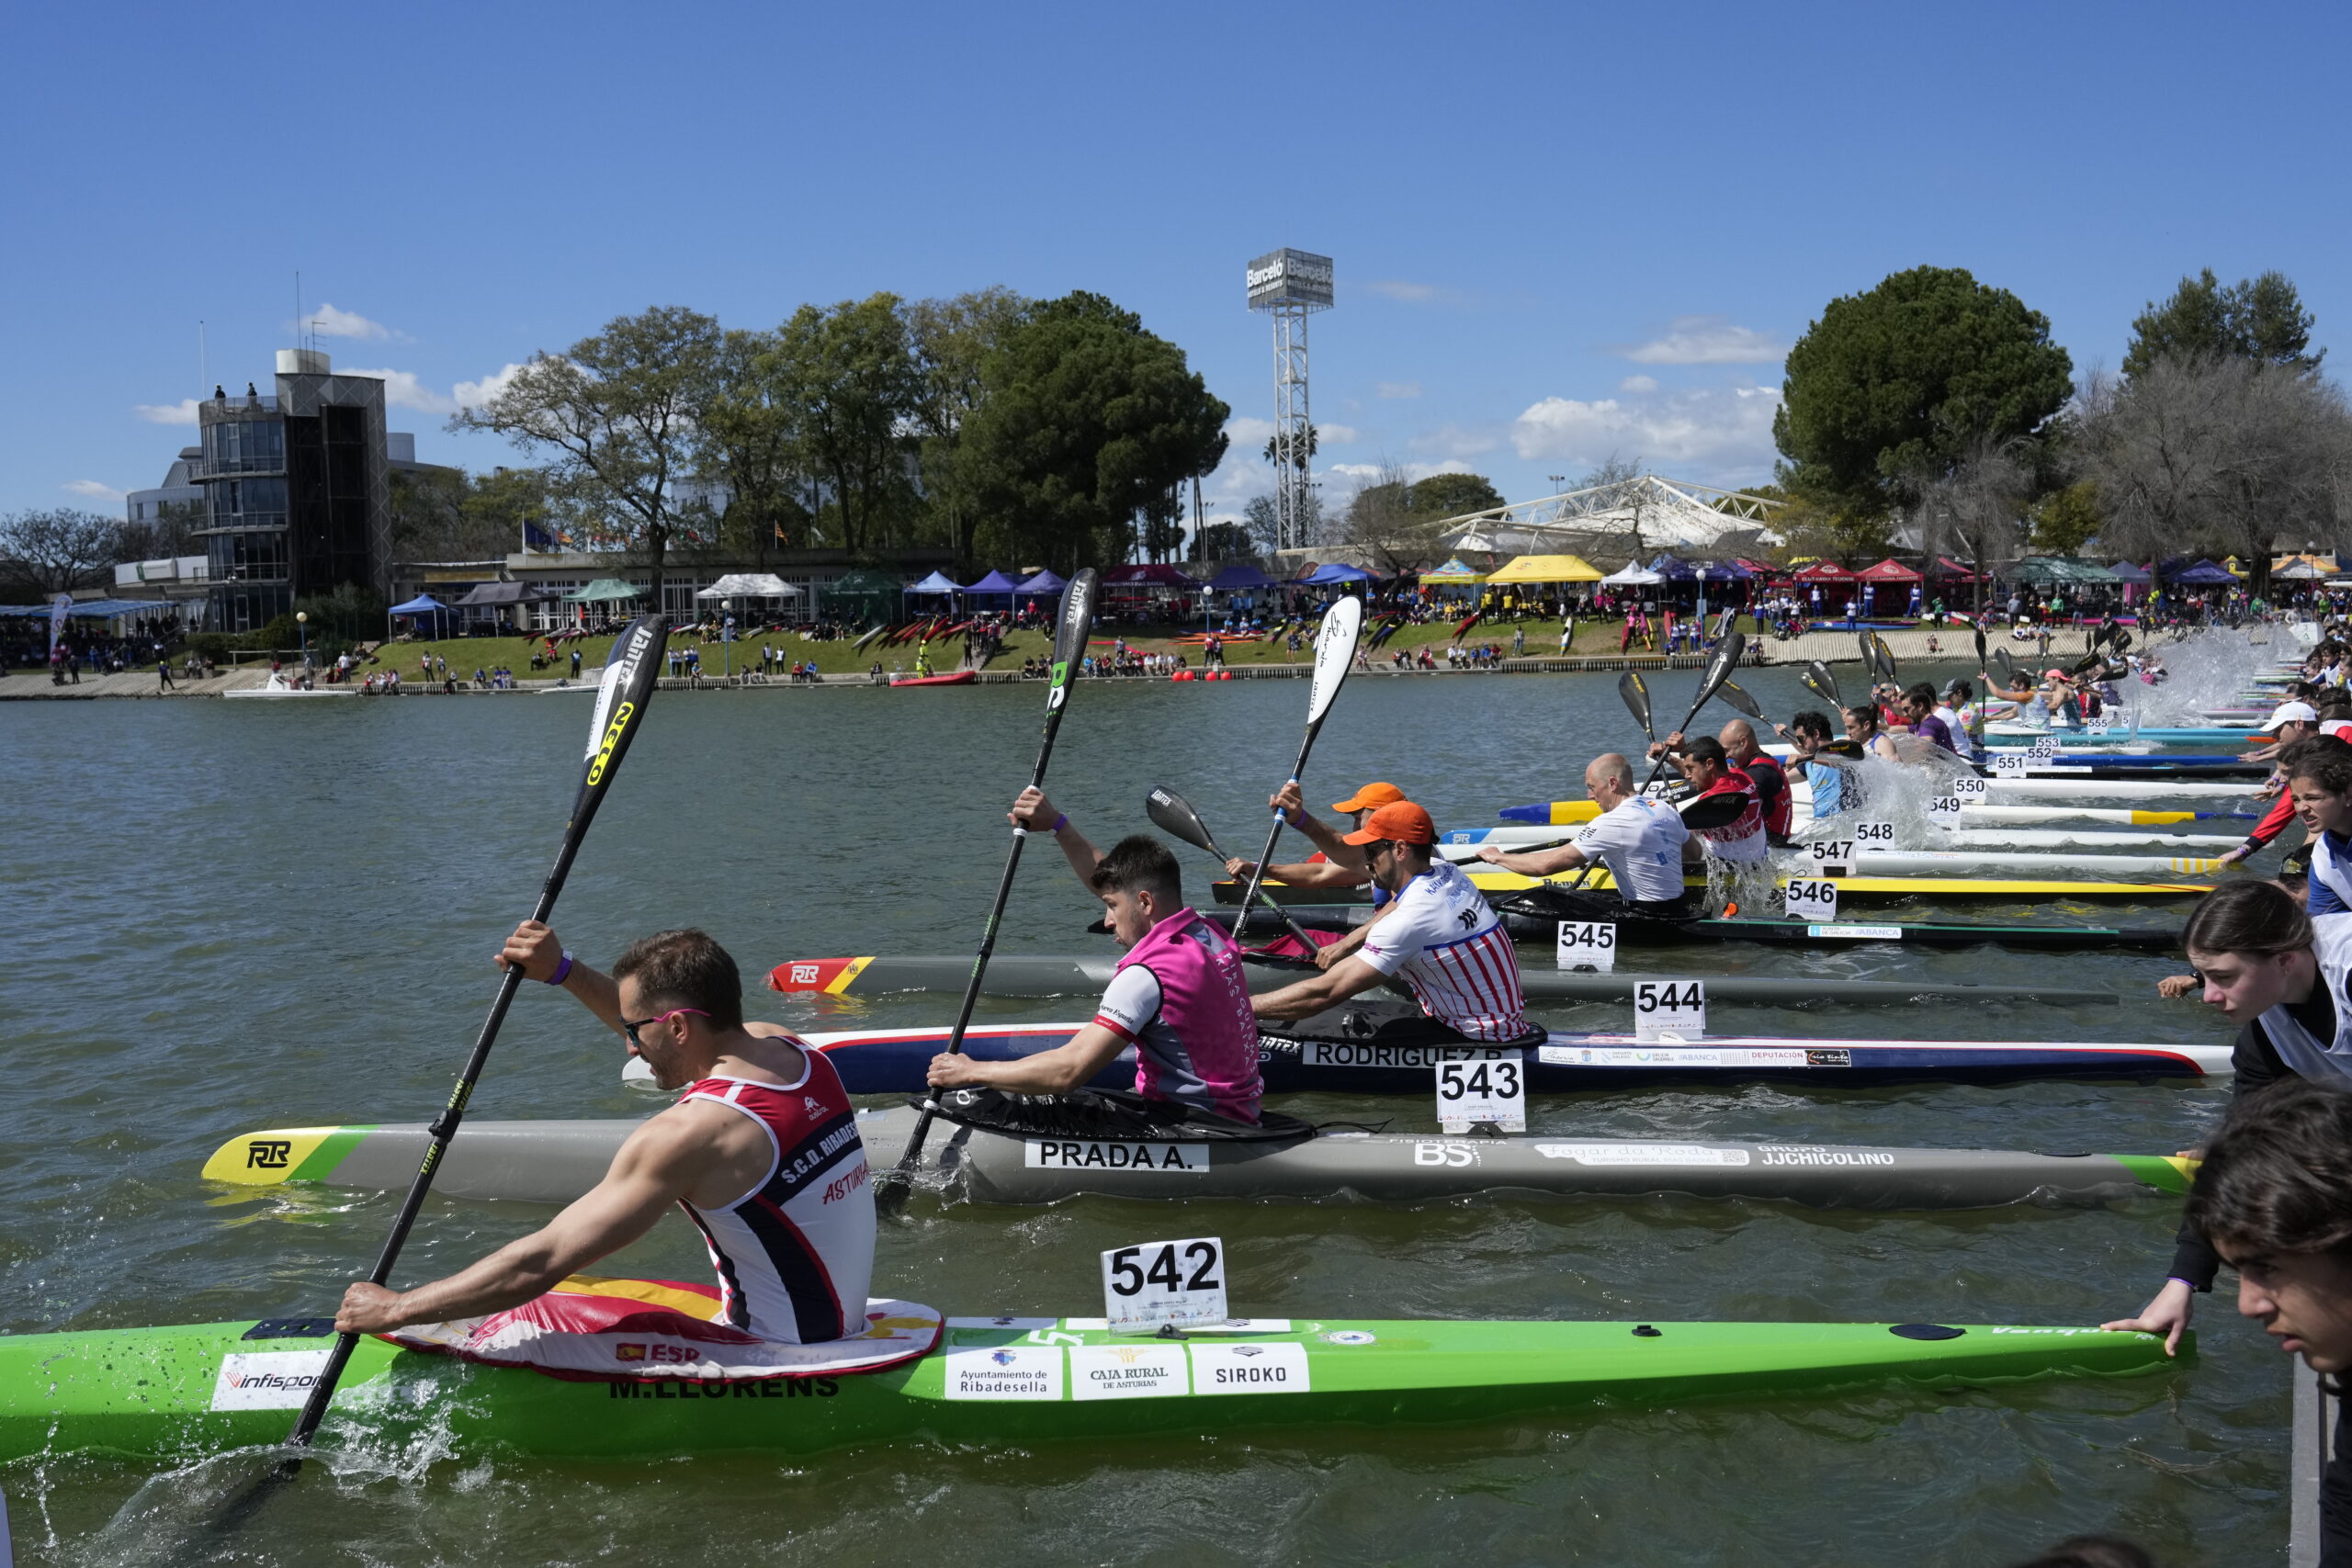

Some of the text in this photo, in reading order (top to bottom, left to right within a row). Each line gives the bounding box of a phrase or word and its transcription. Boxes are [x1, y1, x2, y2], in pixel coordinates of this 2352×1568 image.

[1247, 258, 1283, 288] Barceló
[1287, 257, 1332, 284] Barceló
[2088, 719, 2108, 728] 555
[2038, 738, 2059, 748] 553
[1998, 757, 2023, 769] 551
[2028, 748, 2052, 759] 552
[1956, 780, 1984, 793] 550
[1931, 797, 1961, 813] 549
[1857, 824, 1893, 840] 548
[1813, 841, 1853, 860] 547
[1788, 881, 1835, 904] 546
[1561, 923, 1613, 949] 545
[1638, 982, 1702, 1013] 544
[1316, 1043, 1476, 1068] RODRIGUEZ
[1441, 1063, 1520, 1100] 543
[1041, 1142, 1193, 1169] PRADA A.
[1762, 1153, 1894, 1166] JJCHICOLINO
[781, 1149, 824, 1184] S.C.D.
[1112, 1241, 1220, 1296] 542
[650, 1343, 701, 1363] ESP
[240, 1373, 322, 1392] infispor
[961, 1370, 1047, 1381] Ayuntamiento de
[1091, 1367, 1169, 1381] CAJA RURAL
[1216, 1367, 1287, 1383] SIROKO
[610, 1376, 840, 1399] M.LLORENS
[960, 1381, 1047, 1393] Ribadesella
[1114, 1380, 1158, 1389] ASTURIAS
